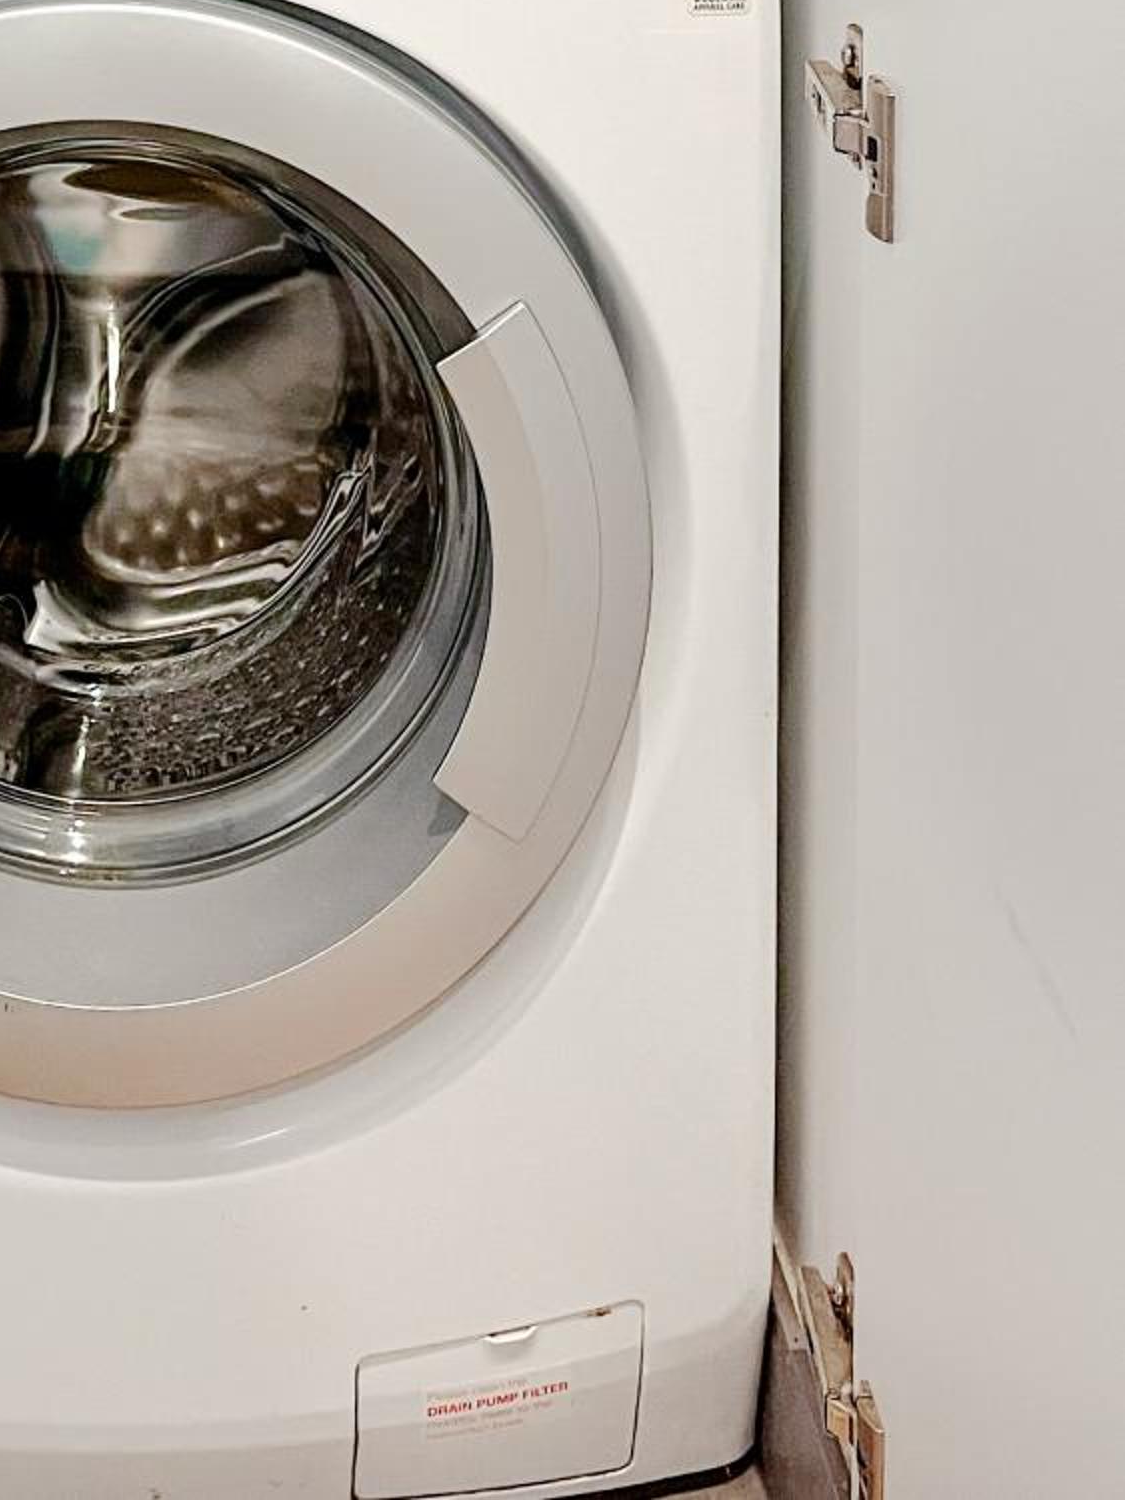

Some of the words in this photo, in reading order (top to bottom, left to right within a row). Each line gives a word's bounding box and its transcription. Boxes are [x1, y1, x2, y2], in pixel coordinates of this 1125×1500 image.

[427, 1402, 472, 1417] DRAIN
[477, 1392, 519, 1408] PUMP
[523, 1382, 568, 1400] FILTER
